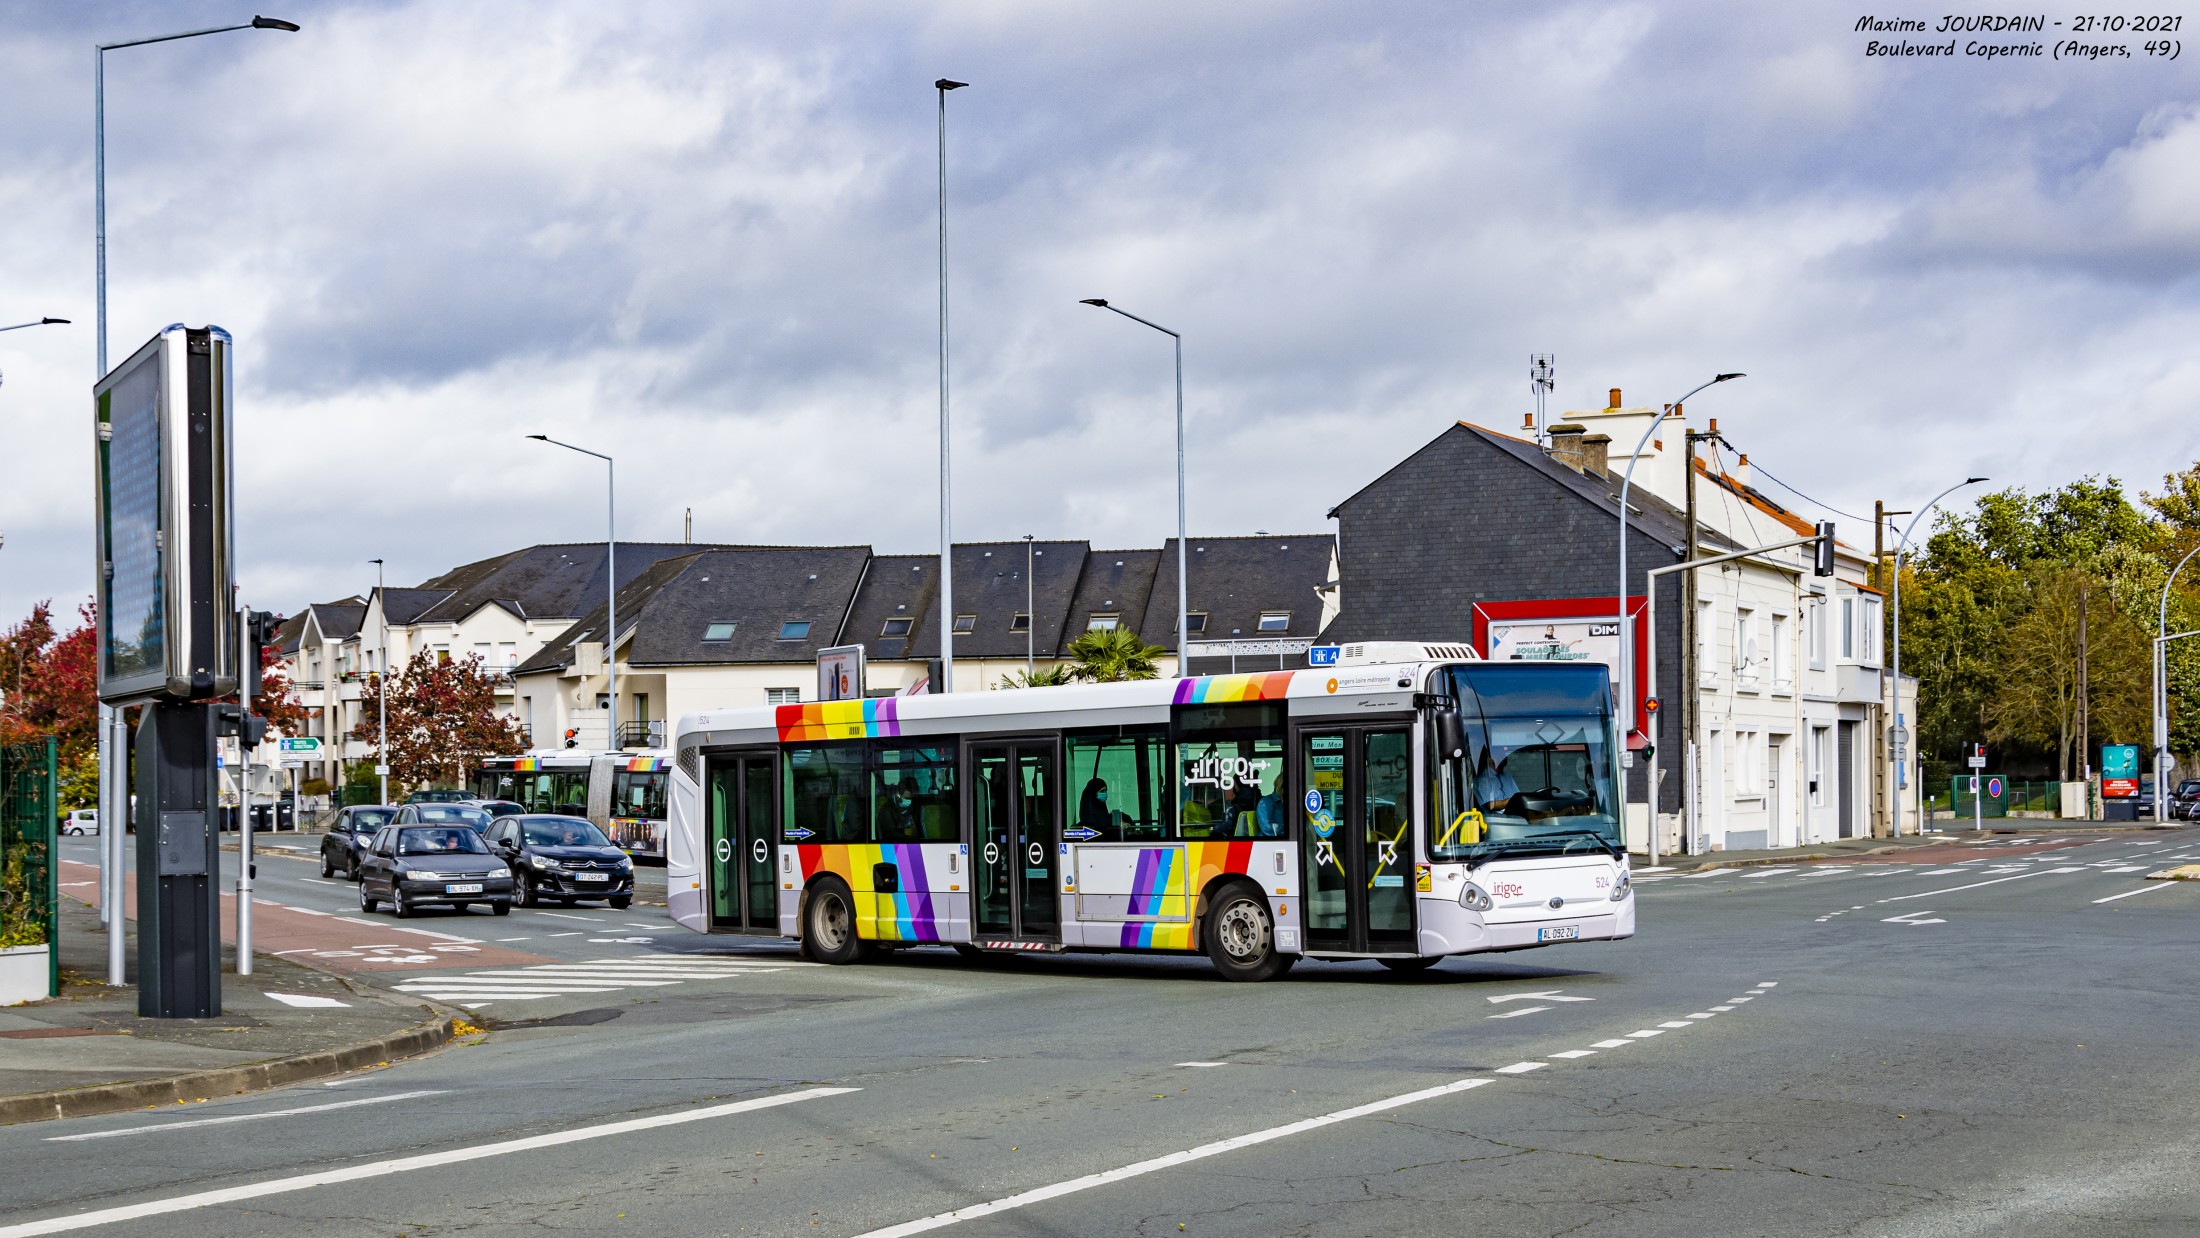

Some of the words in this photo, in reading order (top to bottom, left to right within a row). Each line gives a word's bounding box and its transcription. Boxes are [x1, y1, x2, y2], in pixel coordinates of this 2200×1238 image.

[1592, 624, 1618, 635] DIM
[1516, 646, 1553, 654] SOULAGE
[1399, 667, 1416, 678] 524
[699, 715, 710, 724] 524
[1595, 876, 1610, 888] 524
